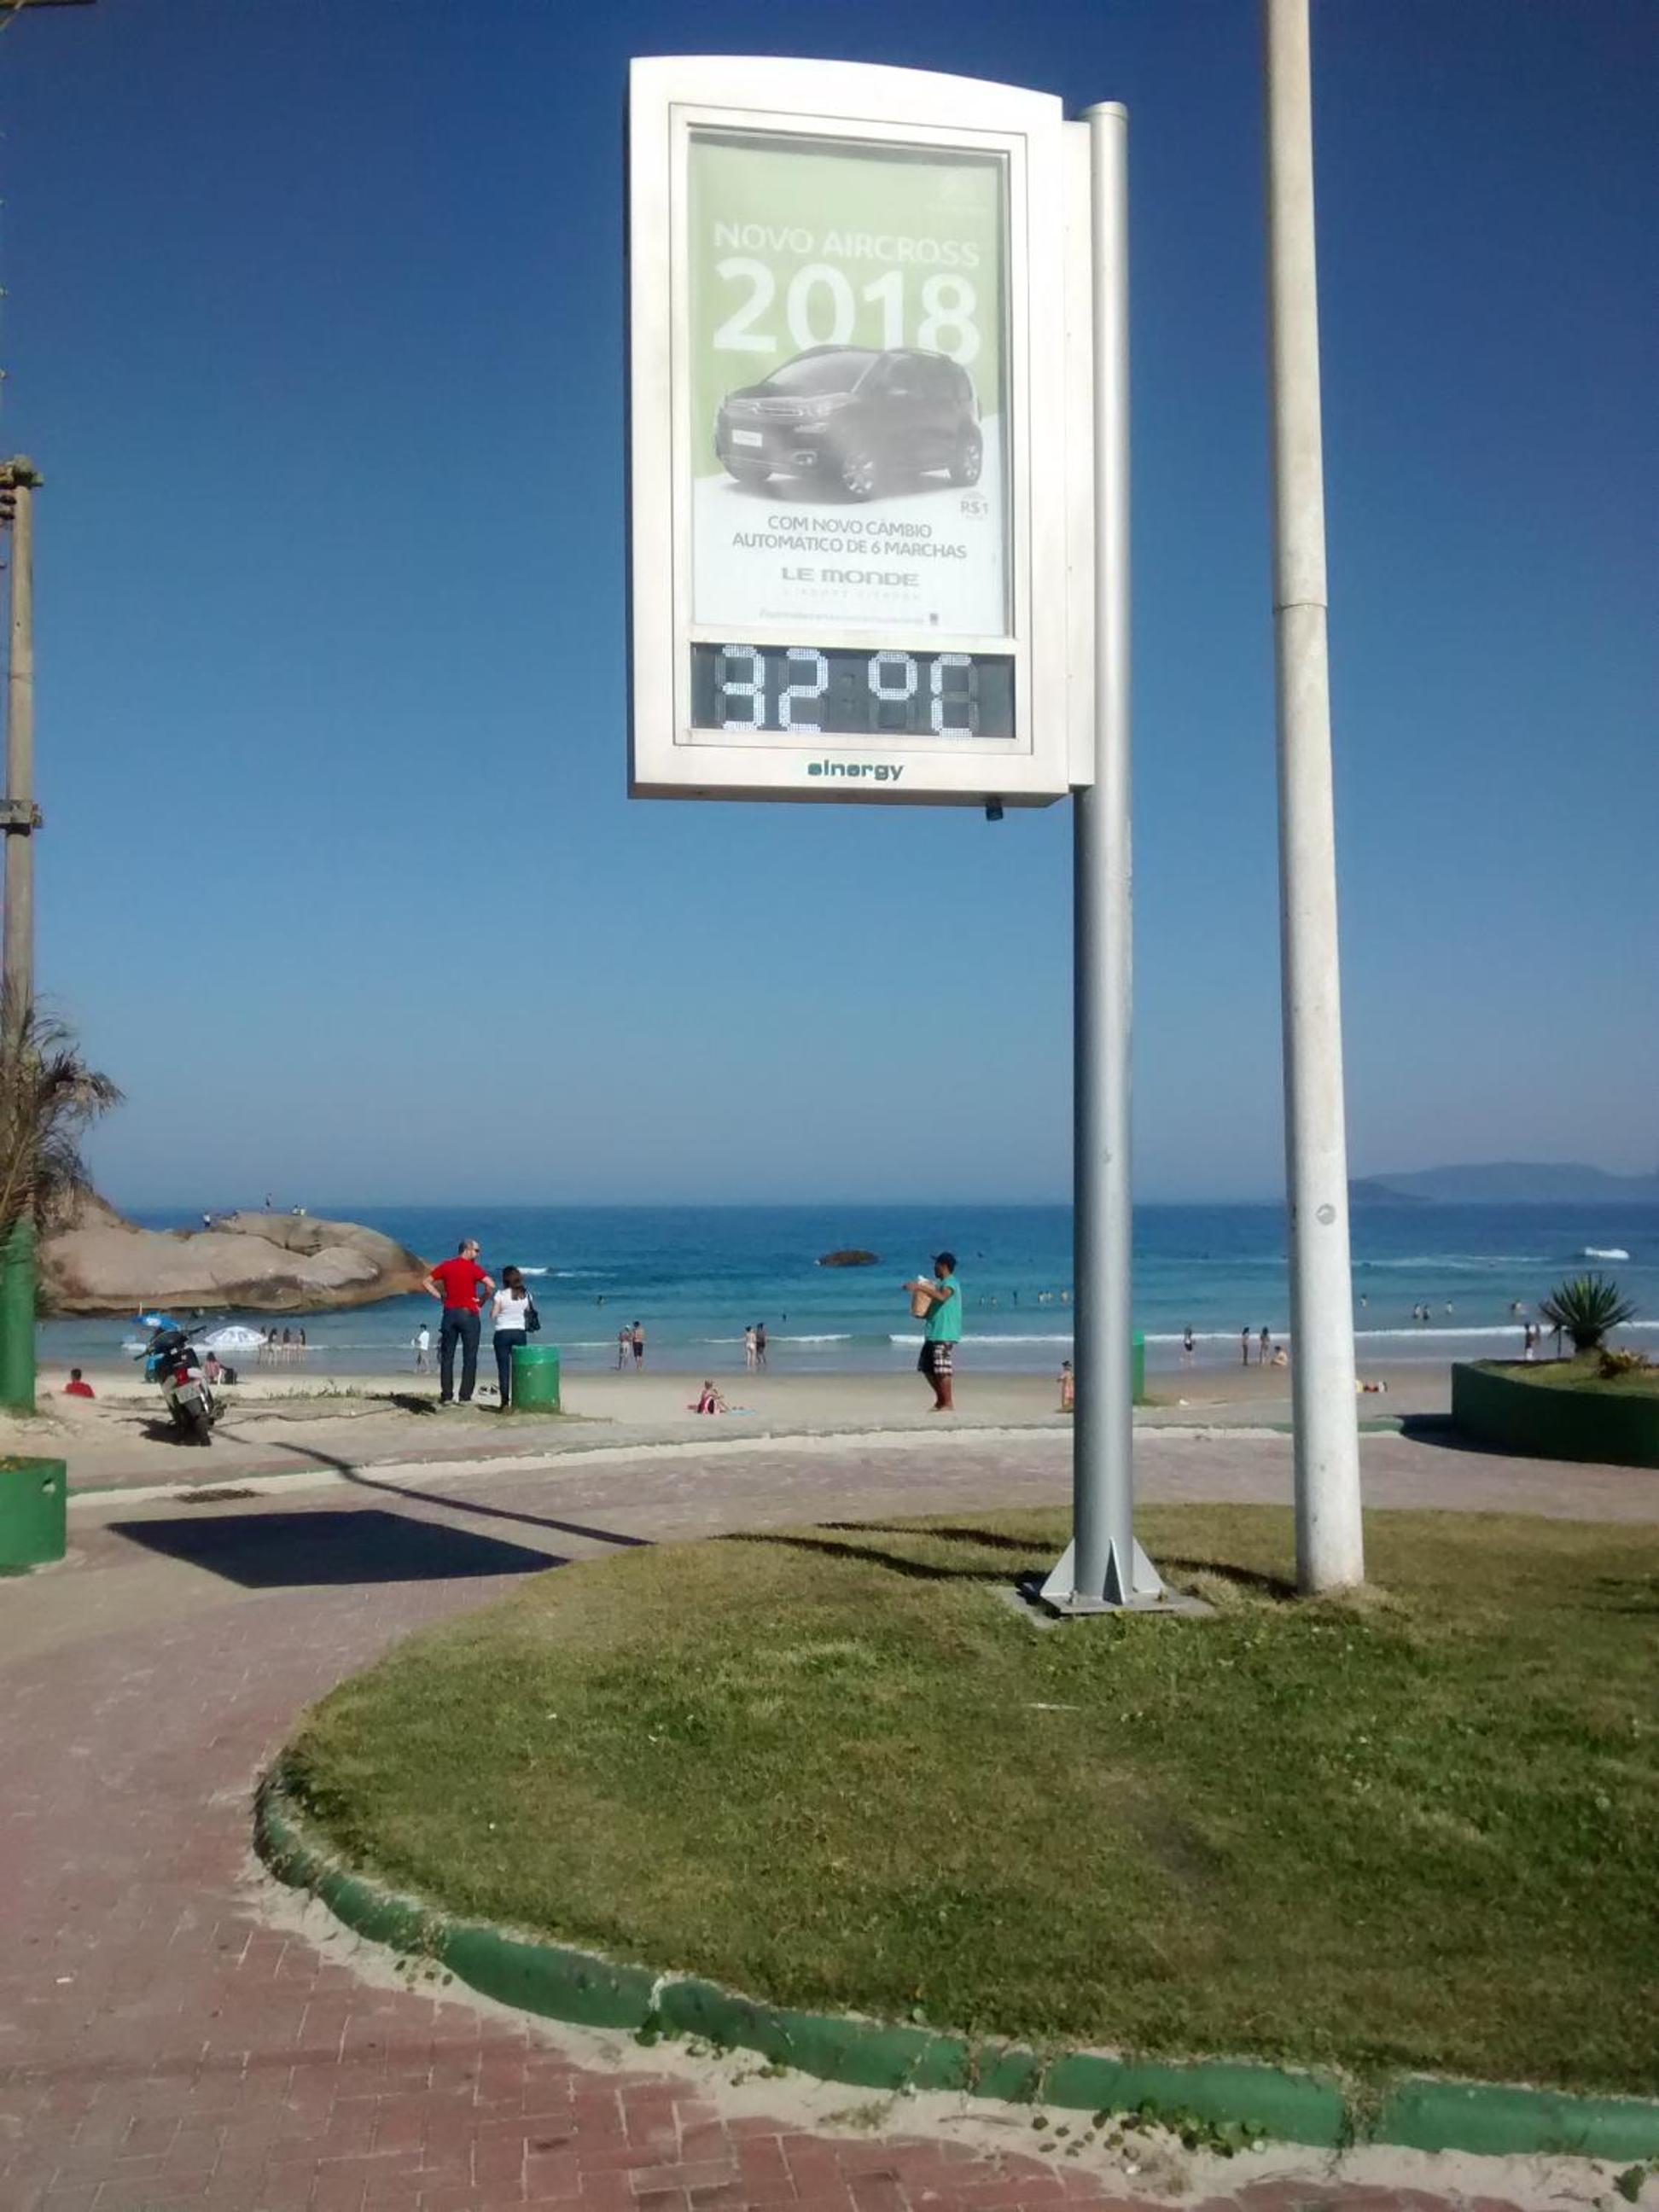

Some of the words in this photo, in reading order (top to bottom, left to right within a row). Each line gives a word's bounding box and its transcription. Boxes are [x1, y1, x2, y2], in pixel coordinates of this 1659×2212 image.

[713, 223, 812, 253] NOVO
[822, 230, 980, 267] AIRCROSS
[713, 256, 981, 364] 2018
[767, 515, 809, 532] COM
[813, 517, 863, 535] NOVO
[847, 539, 868, 554] DE
[870, 539, 882, 555] 6
[884, 541, 967, 559] MARCHAS
[782, 567, 814, 582] LE
[822, 568, 920, 587] MONDE
[722, 645, 828, 732] 32
